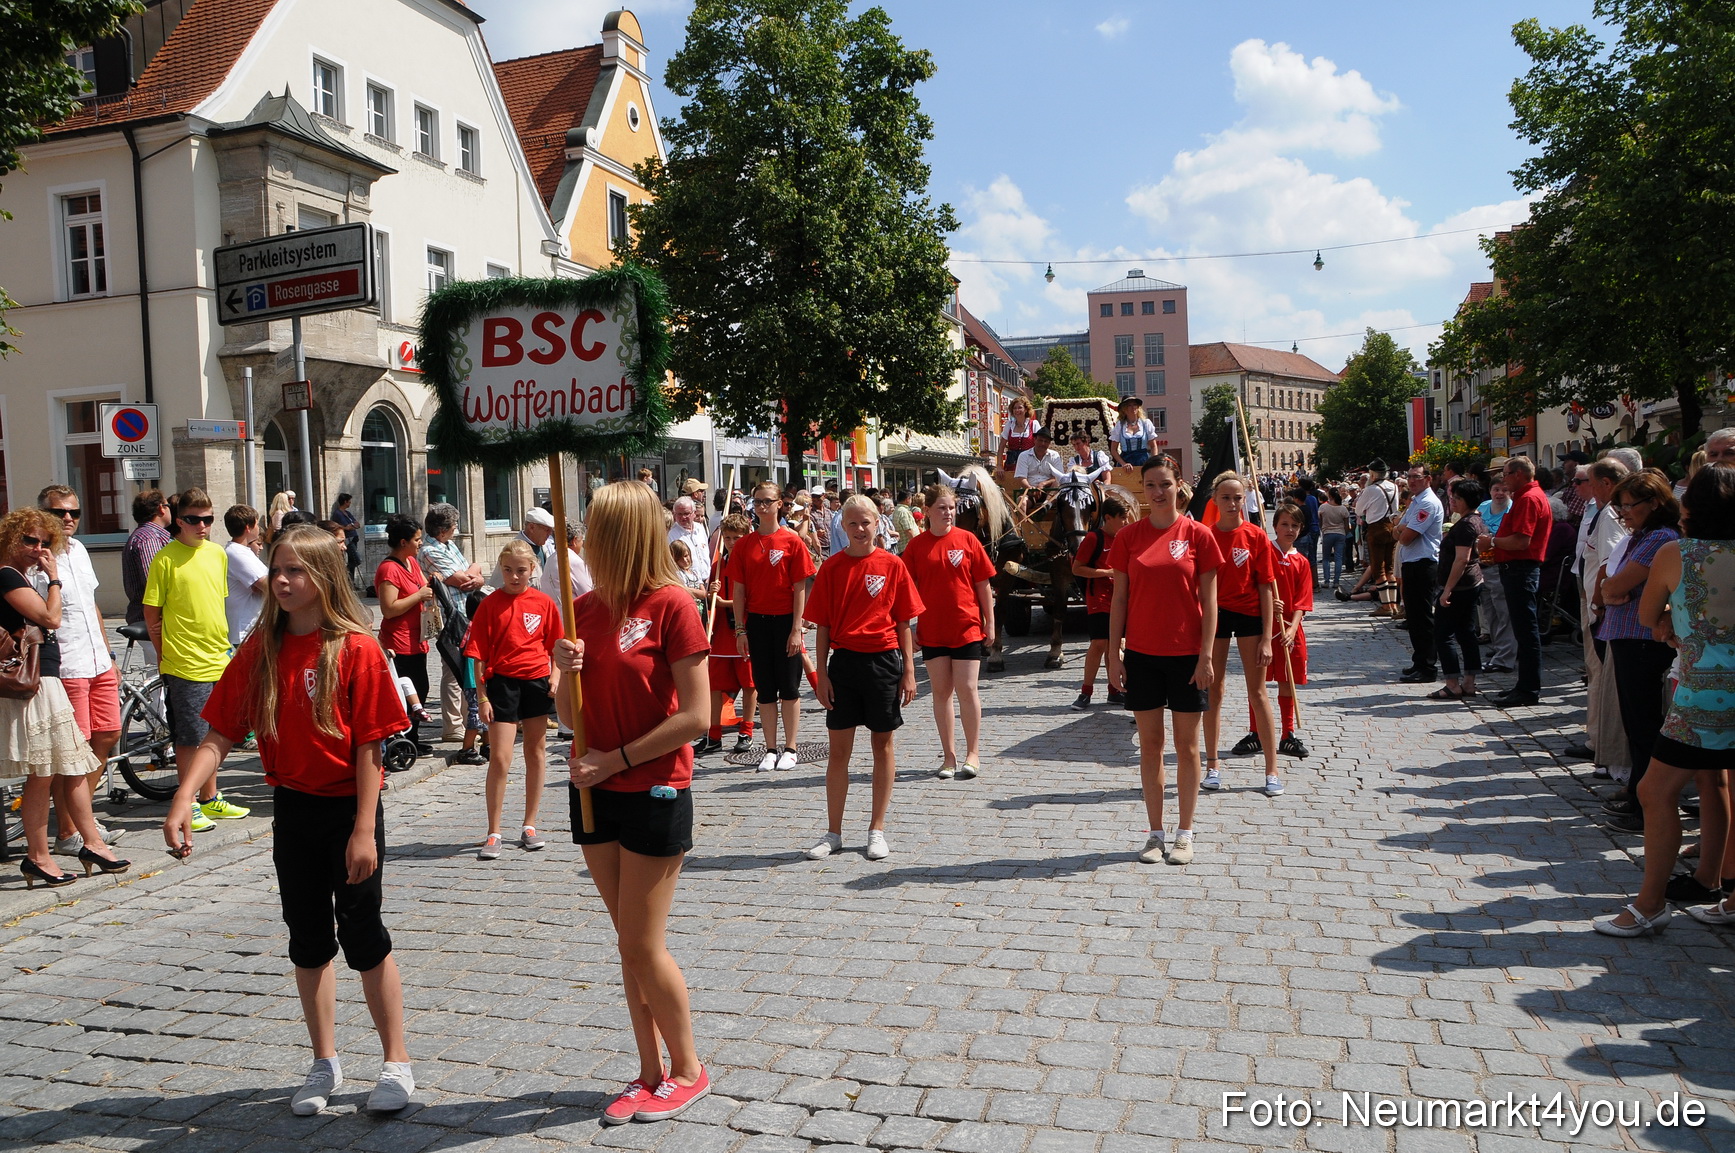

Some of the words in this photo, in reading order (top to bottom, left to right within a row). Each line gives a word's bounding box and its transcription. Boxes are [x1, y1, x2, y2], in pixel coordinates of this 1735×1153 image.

[239, 241, 337, 273] Parkleitsystem
[275, 279, 340, 301] Rosengasse
[482, 309, 607, 368] BSC
[463, 377, 636, 430] Woffenbach
[117, 444, 146, 453] ZONE
